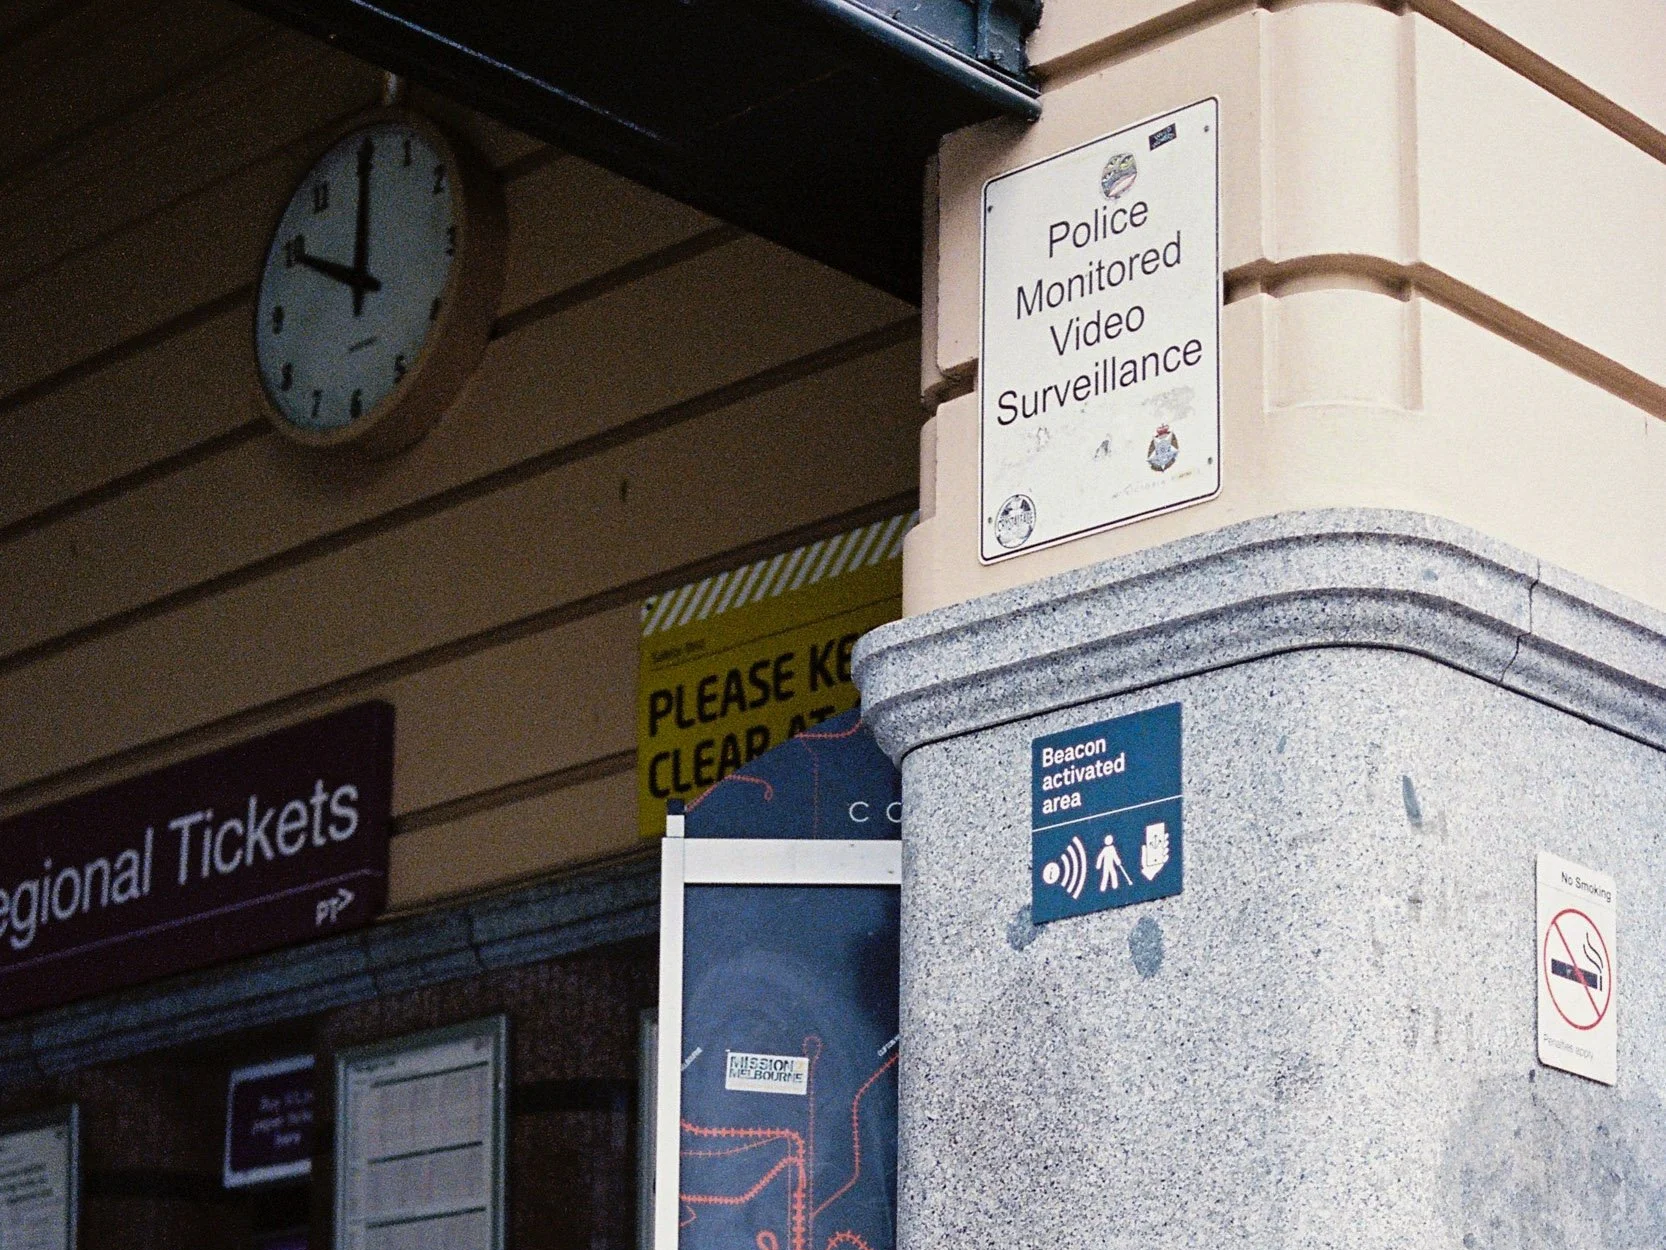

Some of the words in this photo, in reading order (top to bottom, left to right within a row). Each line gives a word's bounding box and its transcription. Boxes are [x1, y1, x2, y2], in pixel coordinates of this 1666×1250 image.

[1048, 199, 1149, 258] Police
[1016, 231, 1183, 320] Monitored
[1049, 303, 1146, 356] Video
[997, 338, 1202, 426] Surveillance
[649, 652, 795, 738] PLEASE
[650, 724, 771, 799] CLEAR
[1042, 738, 1106, 768] Beacon
[1042, 752, 1126, 791] activated
[1042, 792, 1082, 815] area
[168, 779, 359, 885] Tickets
[1561, 871, 1574, 886] No
[1575, 876, 1611, 903] Smoking
[729, 1068, 803, 1083] MELBOURNE
[730, 1056, 794, 1072] MISSION
